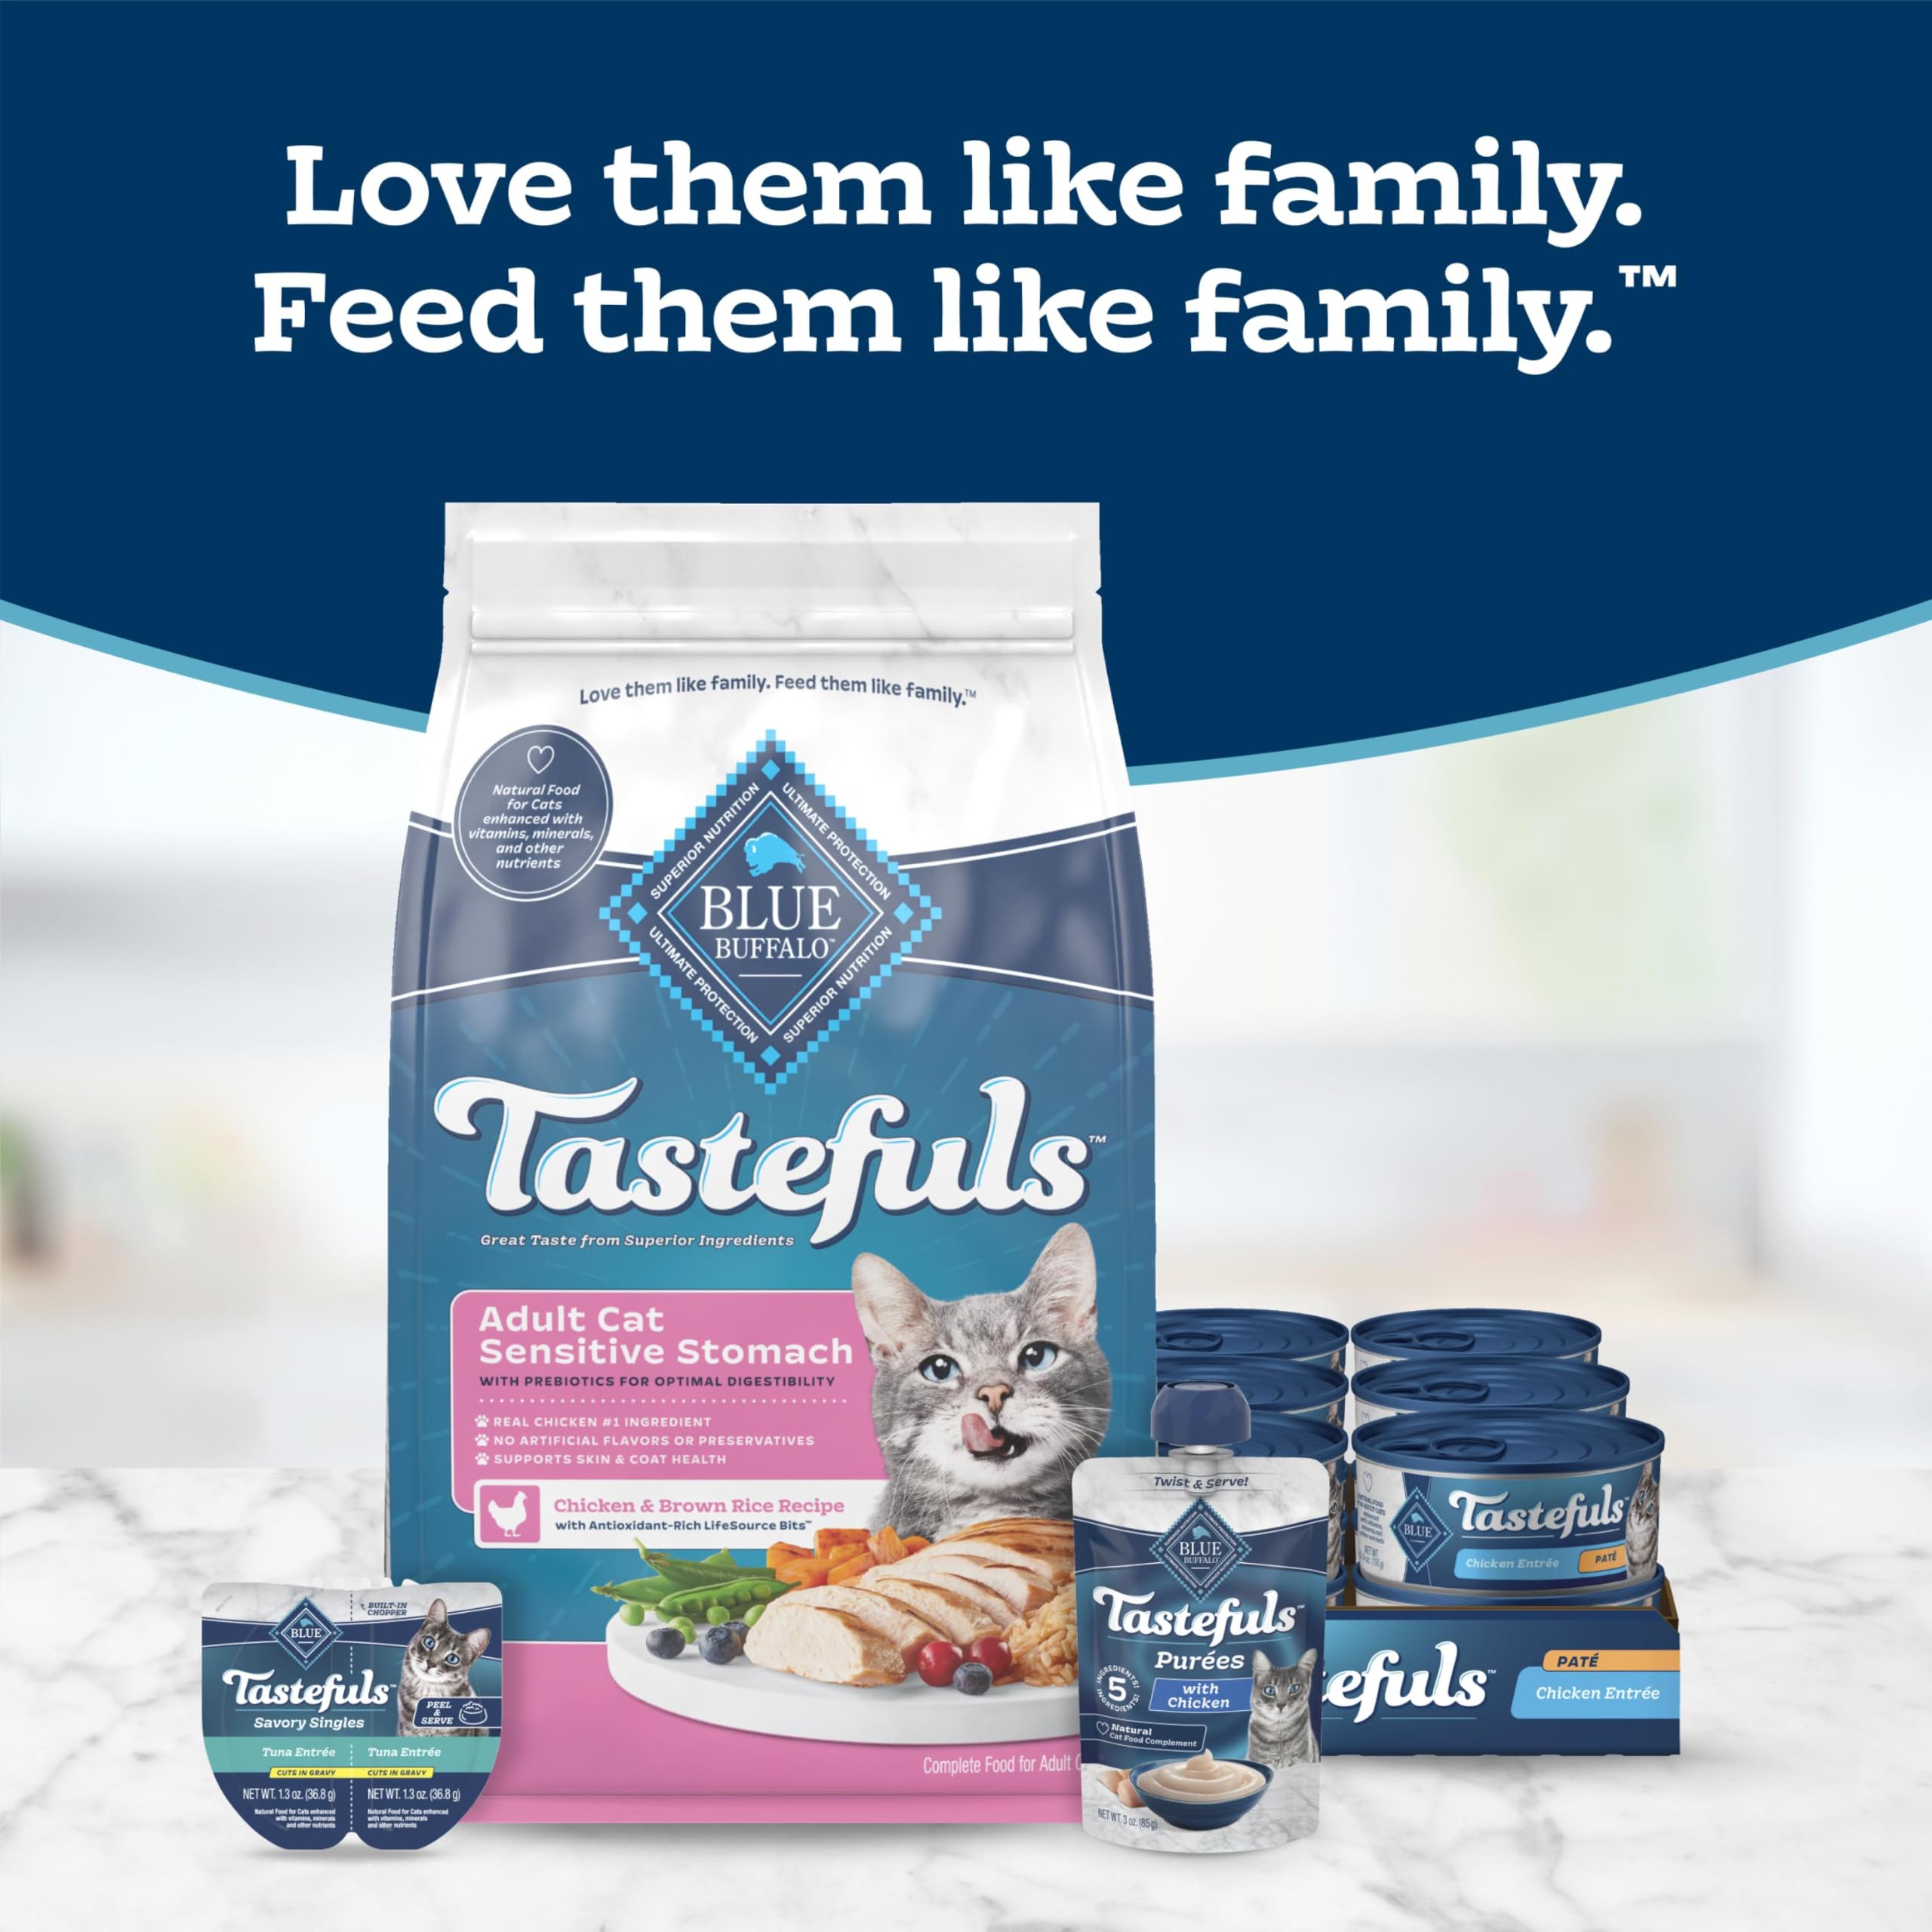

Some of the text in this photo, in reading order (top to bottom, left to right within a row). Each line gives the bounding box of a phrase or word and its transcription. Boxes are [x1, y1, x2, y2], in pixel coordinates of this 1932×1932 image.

[580, 686, 620, 705] Love
[626, 681, 672, 698] them
[676, 676, 706, 693] like
[711, 674, 771, 694] family.
[775, 675, 816, 690] Feed
[820, 676, 866, 693] them
[871, 678, 902, 696] like
[492, 784, 581, 795] Natural Food
[506, 798, 563, 810] for Cats
[483, 813, 583, 824] enhanced with
[469, 827, 594, 841] vitamins, minerals,
[651, 782, 760, 900] SUPERIOR NUTRITION
[782, 782, 892, 900] ULTIMATE PROTECTION
[496, 842, 564, 854] and other
[496, 857, 561, 869] nutrients
[700, 885, 841, 930] BLUE
[649, 926, 759, 1044] ULTIMATE PROTECTION
[783, 926, 893, 1043] SUPERIOR NUTRITION
[481, 1235, 795, 1249] Great Taste from Superior Ingredients
[478, 1305, 664, 1332] Adult Cat
[479, 1337, 854, 1364] Sensitive Stomach
[479, 1376, 835, 1387] WITH PREBIOTICS FOR OPTIMAL DIGESTIBILITY
[494, 1417, 712, 1427] REAL CHICKEN #1 INGREDIENT
[494, 1435, 815, 1446] NO ARTIFICIAL FLAVORS OR PRESERVATIVES
[494, 1454, 727, 1465] SUPPORTS SKIN & COAT HEALTH
[1155, 1476, 1249, 1489] Twist & Serve!
[554, 1498, 844, 1517] Chicken & Brown Rice Recipe
[555, 1520, 586, 1531] with
[589, 1520, 701, 1531] Antioxidant-Rich
[704, 1520, 776, 1531] LifeSource
[1404, 1524, 1433, 1537] BLUE
[1180, 1541, 1222, 1555] BLUE
[1466, 1557, 1559, 1568] Chicken Entrée
[1595, 1552, 1617, 1564] PATÉ
[291, 1629, 322, 1638] BLUE
[1154, 1649, 1244, 1670] Purées
[1557, 1653, 1600, 1667] PATÉ
[1097, 1665, 1140, 1688] INGREDIENTS!
[1108, 1676, 1127, 1702] 5
[1183, 1683, 1219, 1694] with
[1536, 1685, 1660, 1700] Chicken Entrée
[1097, 1689, 1140, 1712] INGREDIENTS!
[1168, 1697, 1230, 1709] Chicken
[254, 1717, 365, 1730] Savory Singles
[1111, 1723, 1152, 1736] Natural
[1109, 1732, 1197, 1747] Cat Food Complement
[262, 1747, 336, 1757] Tuna Entrée
[368, 1747, 441, 1757] Tuna Entrée
[923, 1756, 981, 1777] Complete
[985, 1755, 1015, 1773] Food
[1019, 1755, 1036, 1772] for
[1039, 1754, 1072, 1771] Adult
[242, 1788, 336, 1802] NET WT. 1.3 oz. (36.8 g)
[368, 1788, 460, 1802] NET WT. 1.3 oz. (36.8 g)
[1098, 1807, 1158, 1831] NET WT. 3 oz. (85 g)
